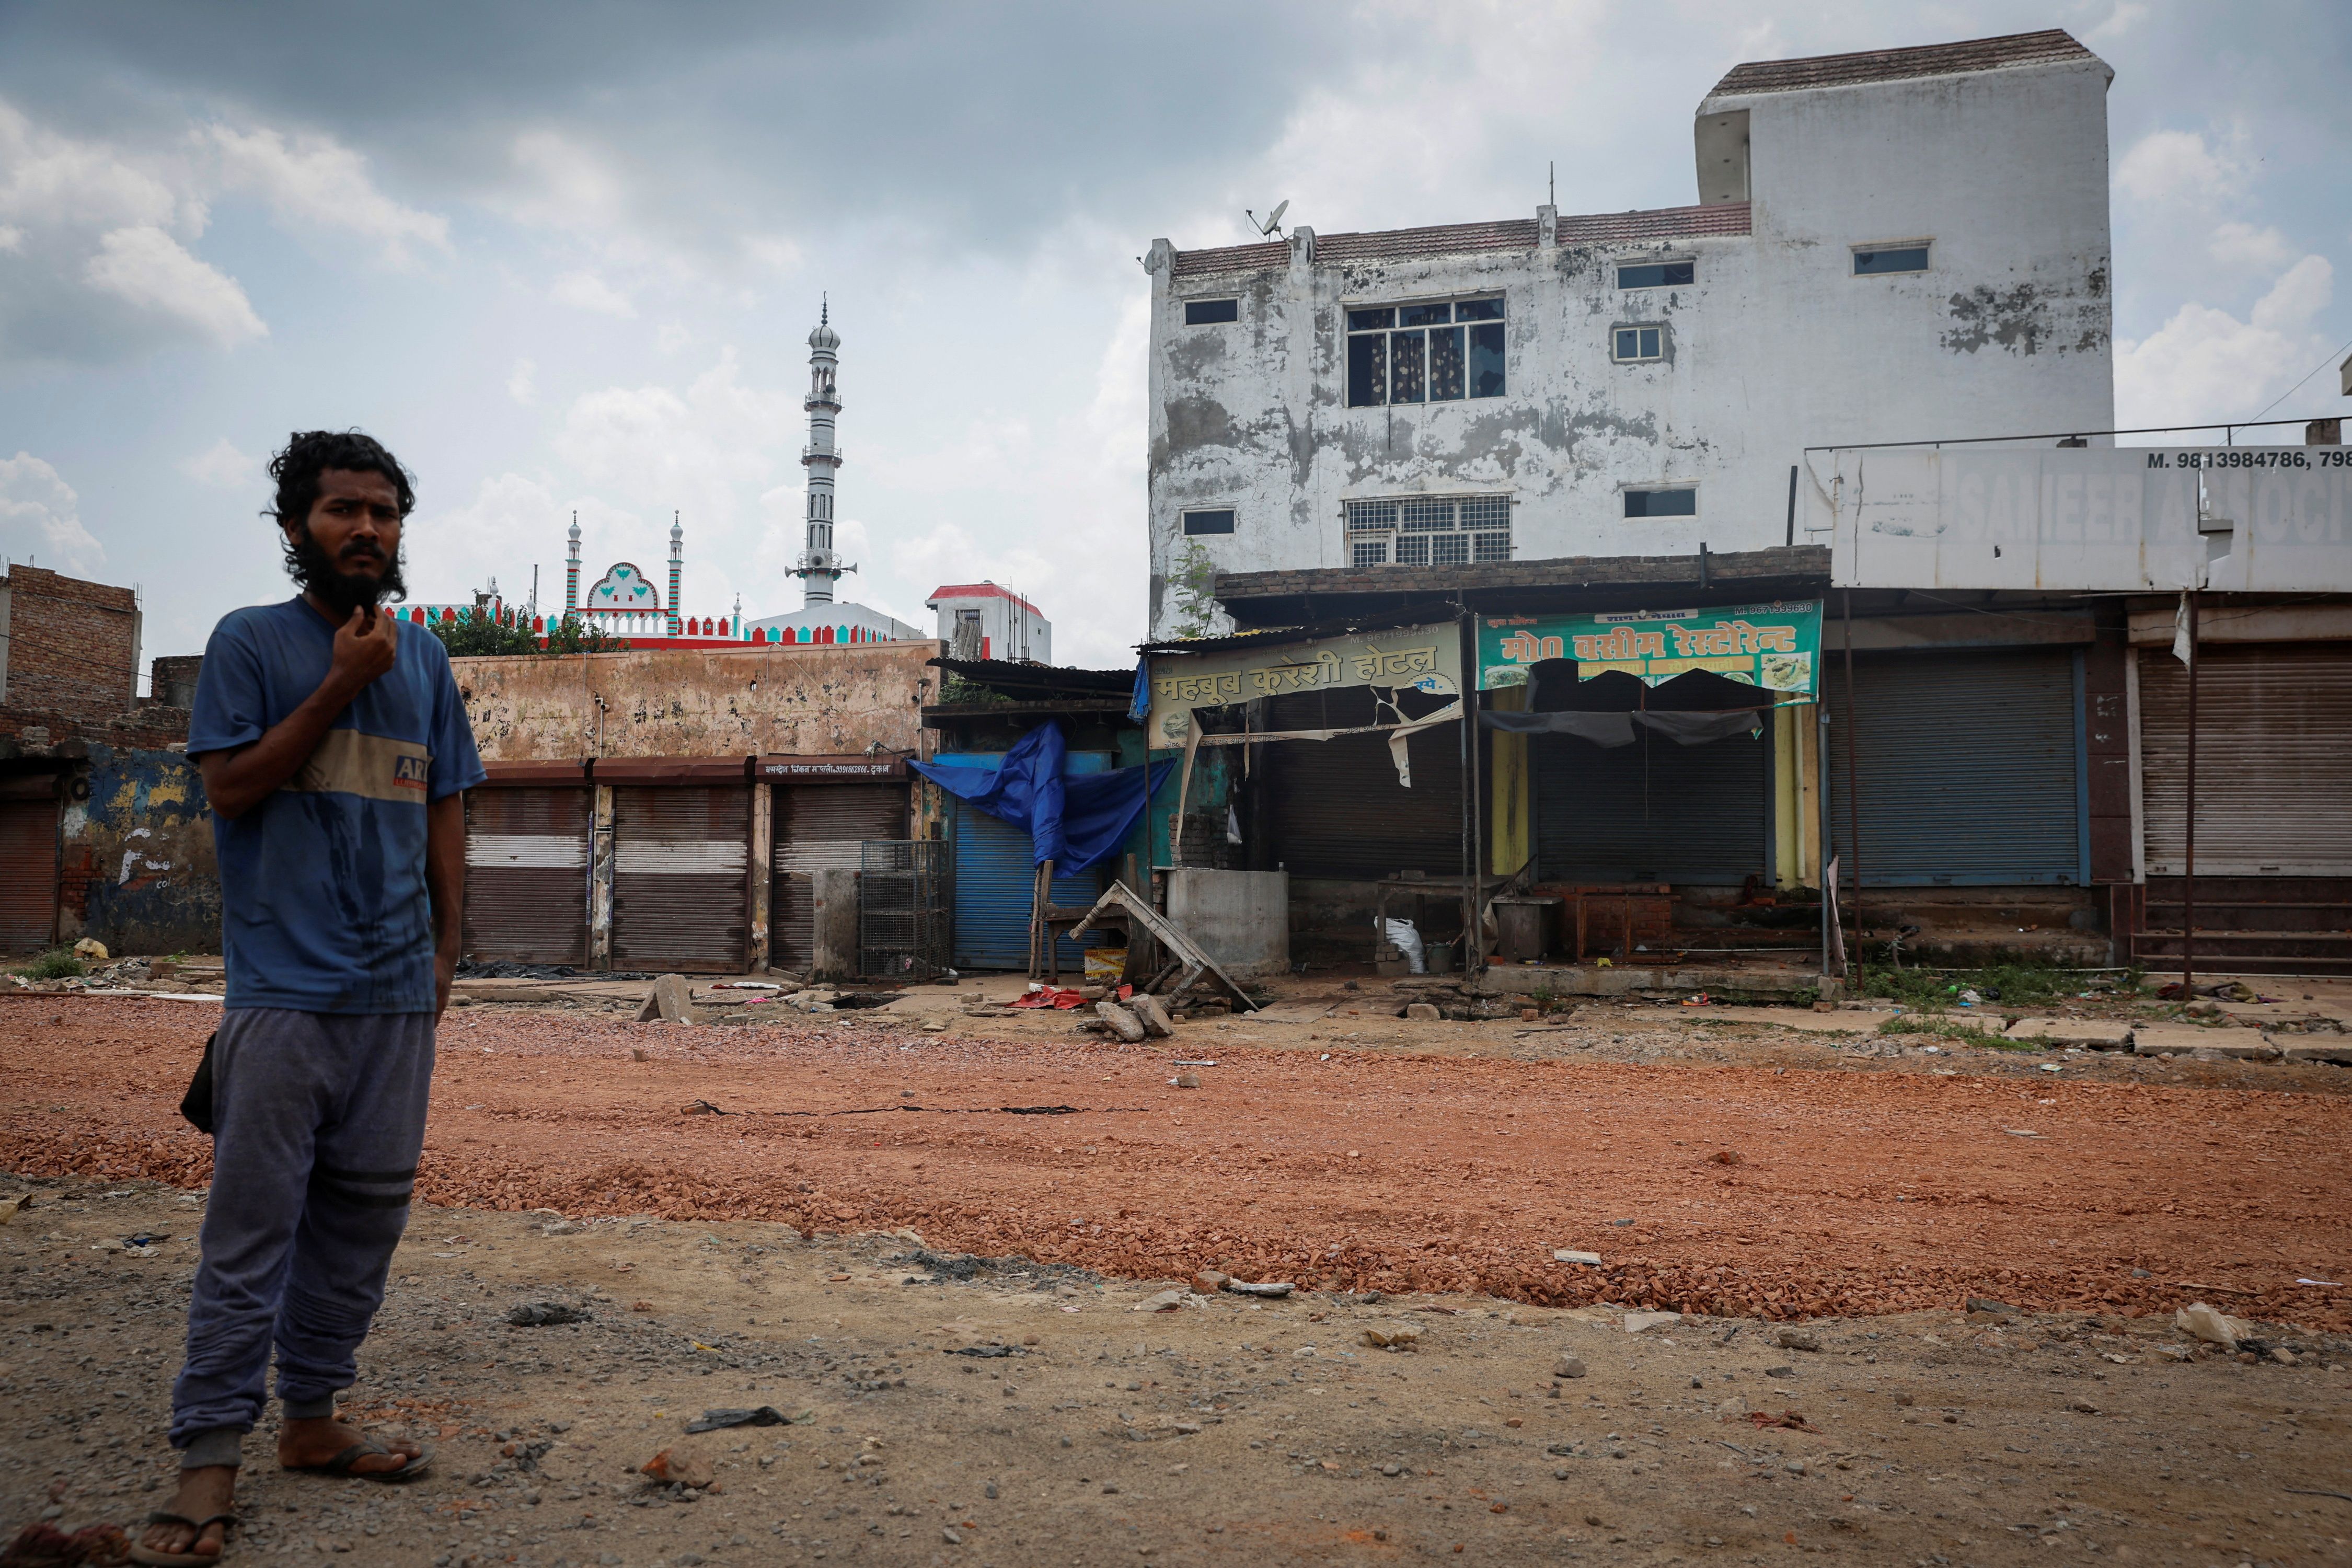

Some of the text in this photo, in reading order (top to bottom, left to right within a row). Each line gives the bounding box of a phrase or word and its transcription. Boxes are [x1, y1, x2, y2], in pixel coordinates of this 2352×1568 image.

[2147, 453, 2170, 468] M.
[1735, 603, 1813, 615] M. 9671999630
[1367, 626, 1439, 642] 9671999630
[1154, 670, 1242, 705] महबूब
[1351, 643, 1438, 680] होटल
